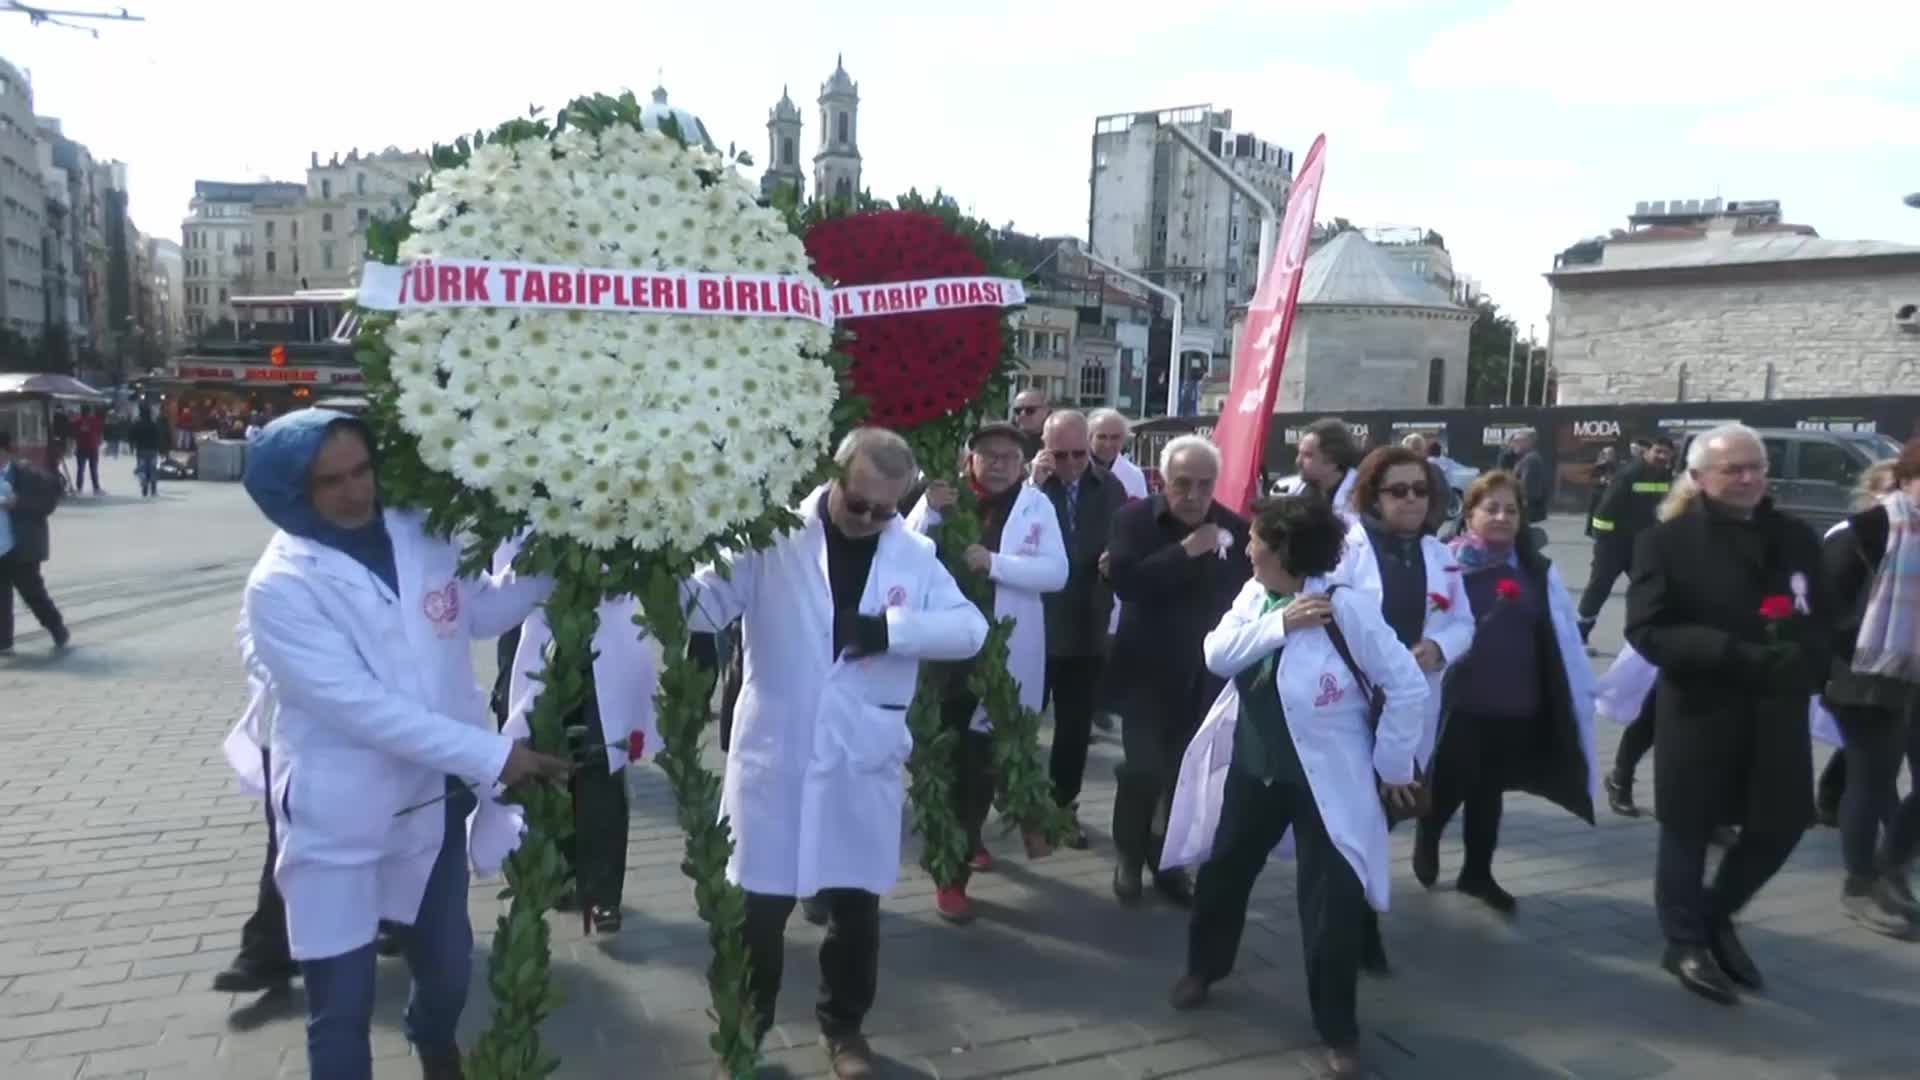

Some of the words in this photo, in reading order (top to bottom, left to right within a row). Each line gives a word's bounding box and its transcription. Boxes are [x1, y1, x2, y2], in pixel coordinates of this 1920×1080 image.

[398, 257, 490, 305] TÜRK
[500, 269, 687, 309] TABİPLERİ
[697, 275, 821, 319] BİRLİĞİ
[857, 282, 928, 313] TABİP
[935, 281, 1004, 305] ODASI
[1573, 420, 1621, 436] MODA
